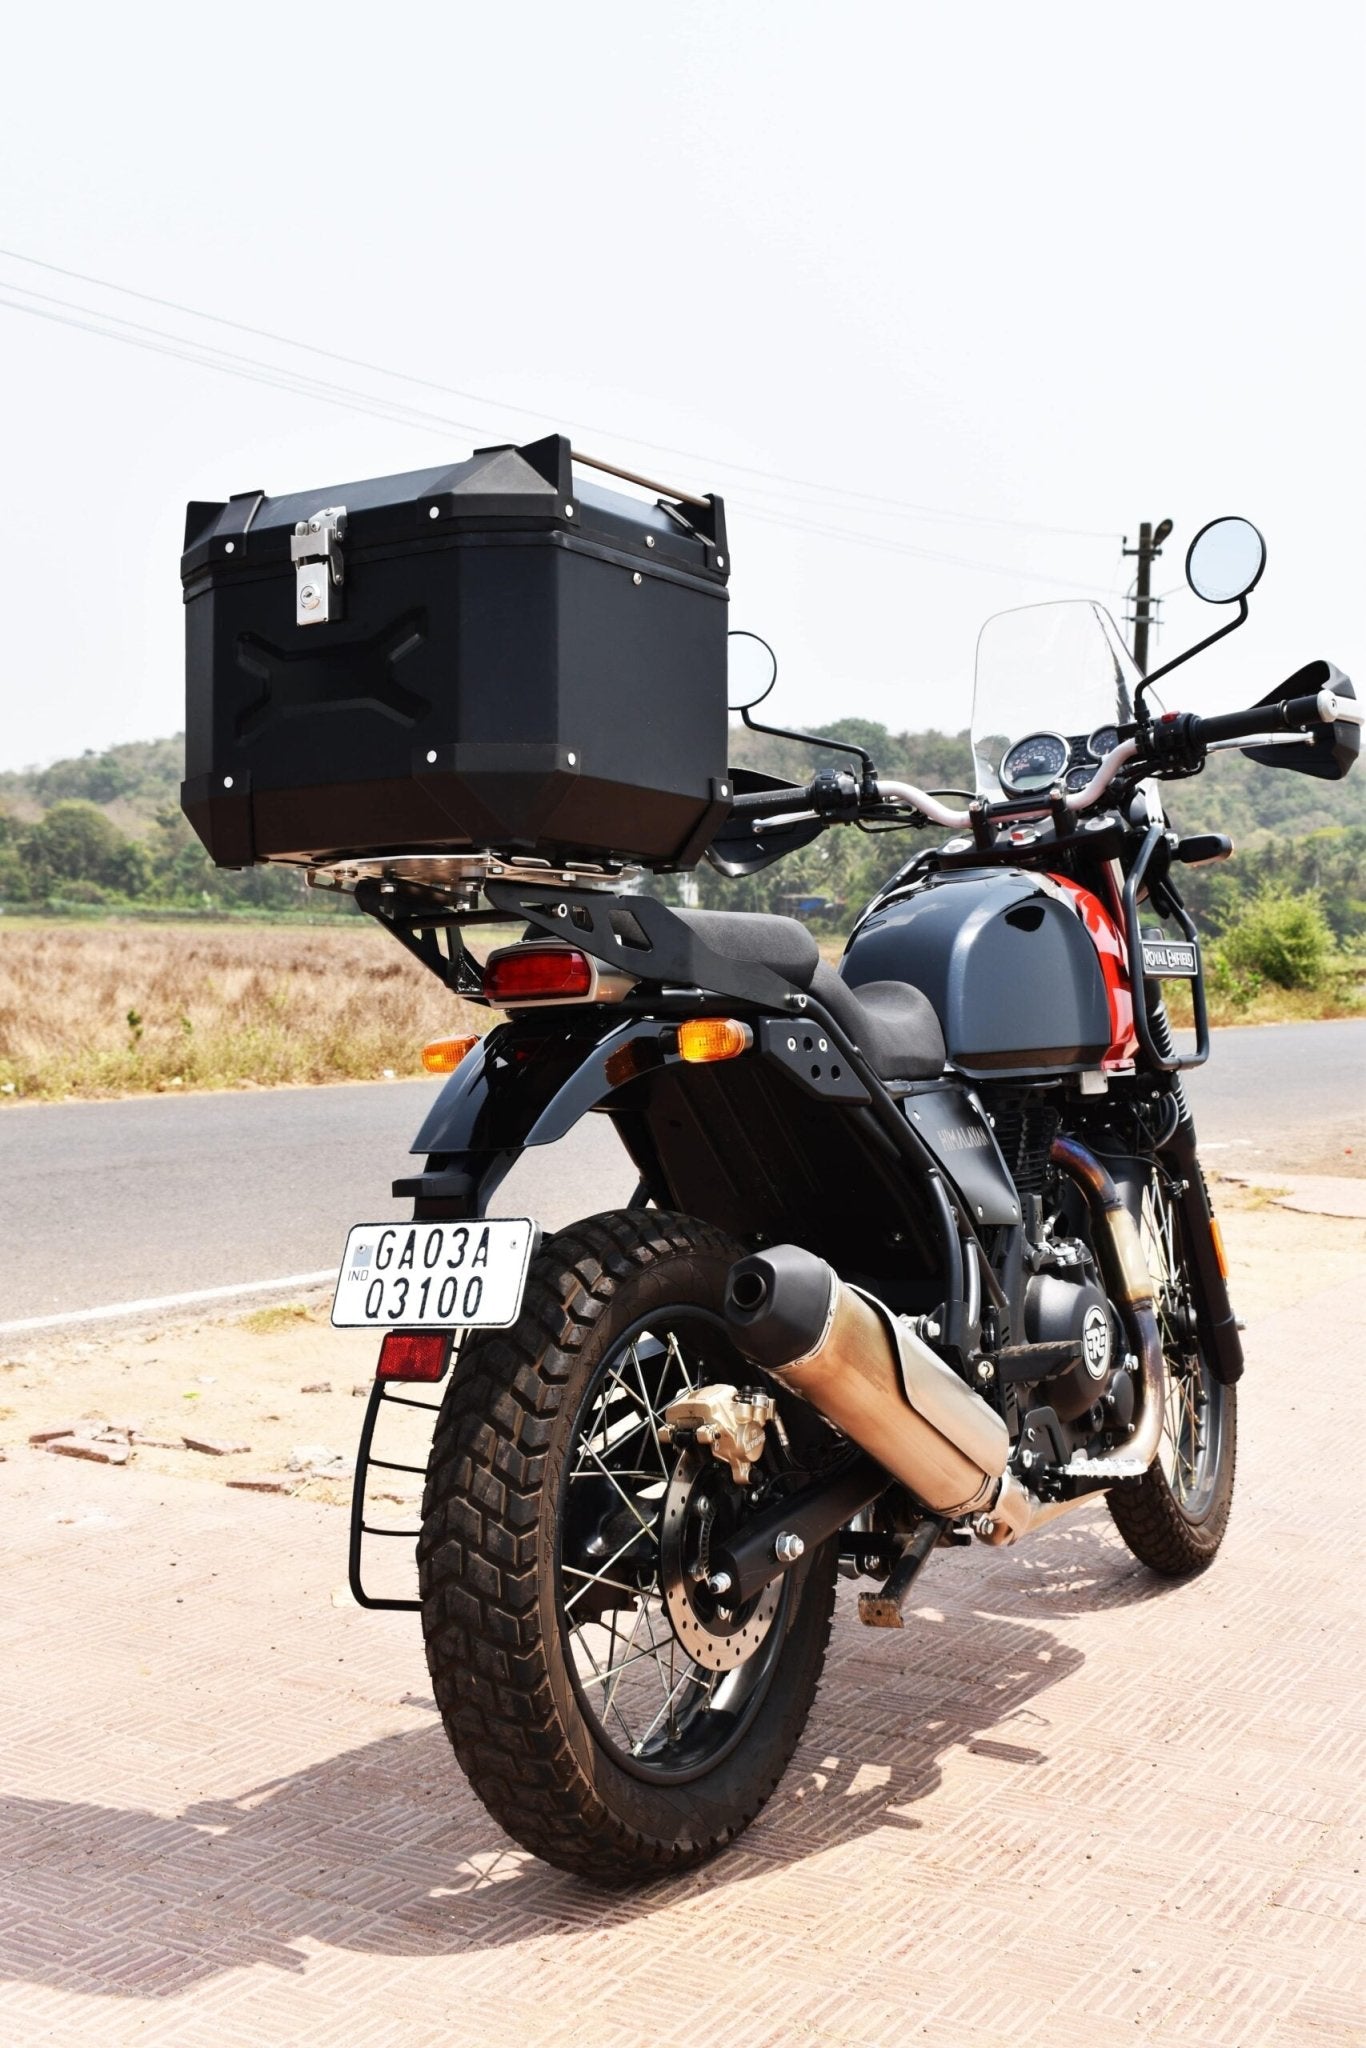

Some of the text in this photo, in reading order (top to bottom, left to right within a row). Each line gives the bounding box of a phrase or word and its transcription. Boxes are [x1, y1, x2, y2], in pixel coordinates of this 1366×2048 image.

[1144, 947, 1194, 968] ROYAL ENFIELD
[937, 1127, 989, 1152] HIMALAYAN
[376, 1227, 490, 1270] GA03A
[348, 1269, 369, 1281] IND
